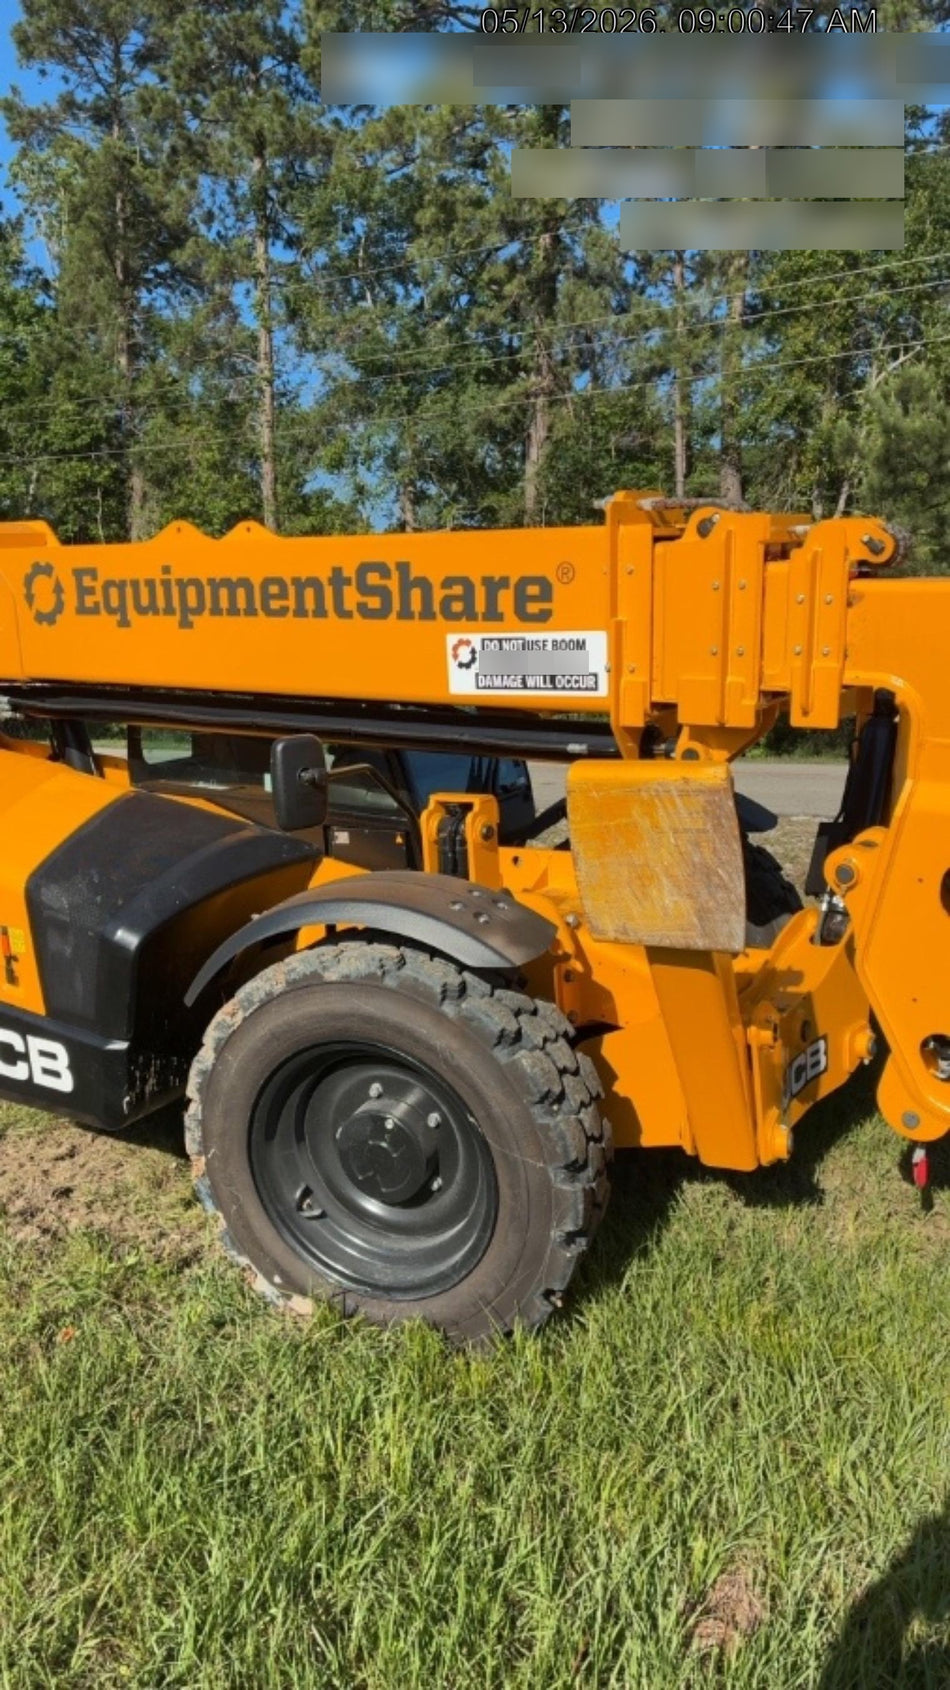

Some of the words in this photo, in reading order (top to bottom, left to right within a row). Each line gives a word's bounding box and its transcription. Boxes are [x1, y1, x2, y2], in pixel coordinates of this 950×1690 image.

[484, 639, 500, 651] DO
[502, 639, 524, 651] NOT
[527, 639, 548, 651] USE
[552, 638, 587, 651] BOOM
[478, 675, 524, 688] DAMAGE
[526, 675, 553, 688] WILL
[555, 675, 596, 689] OCCUR
[0, 1028, 74, 1093] CB
